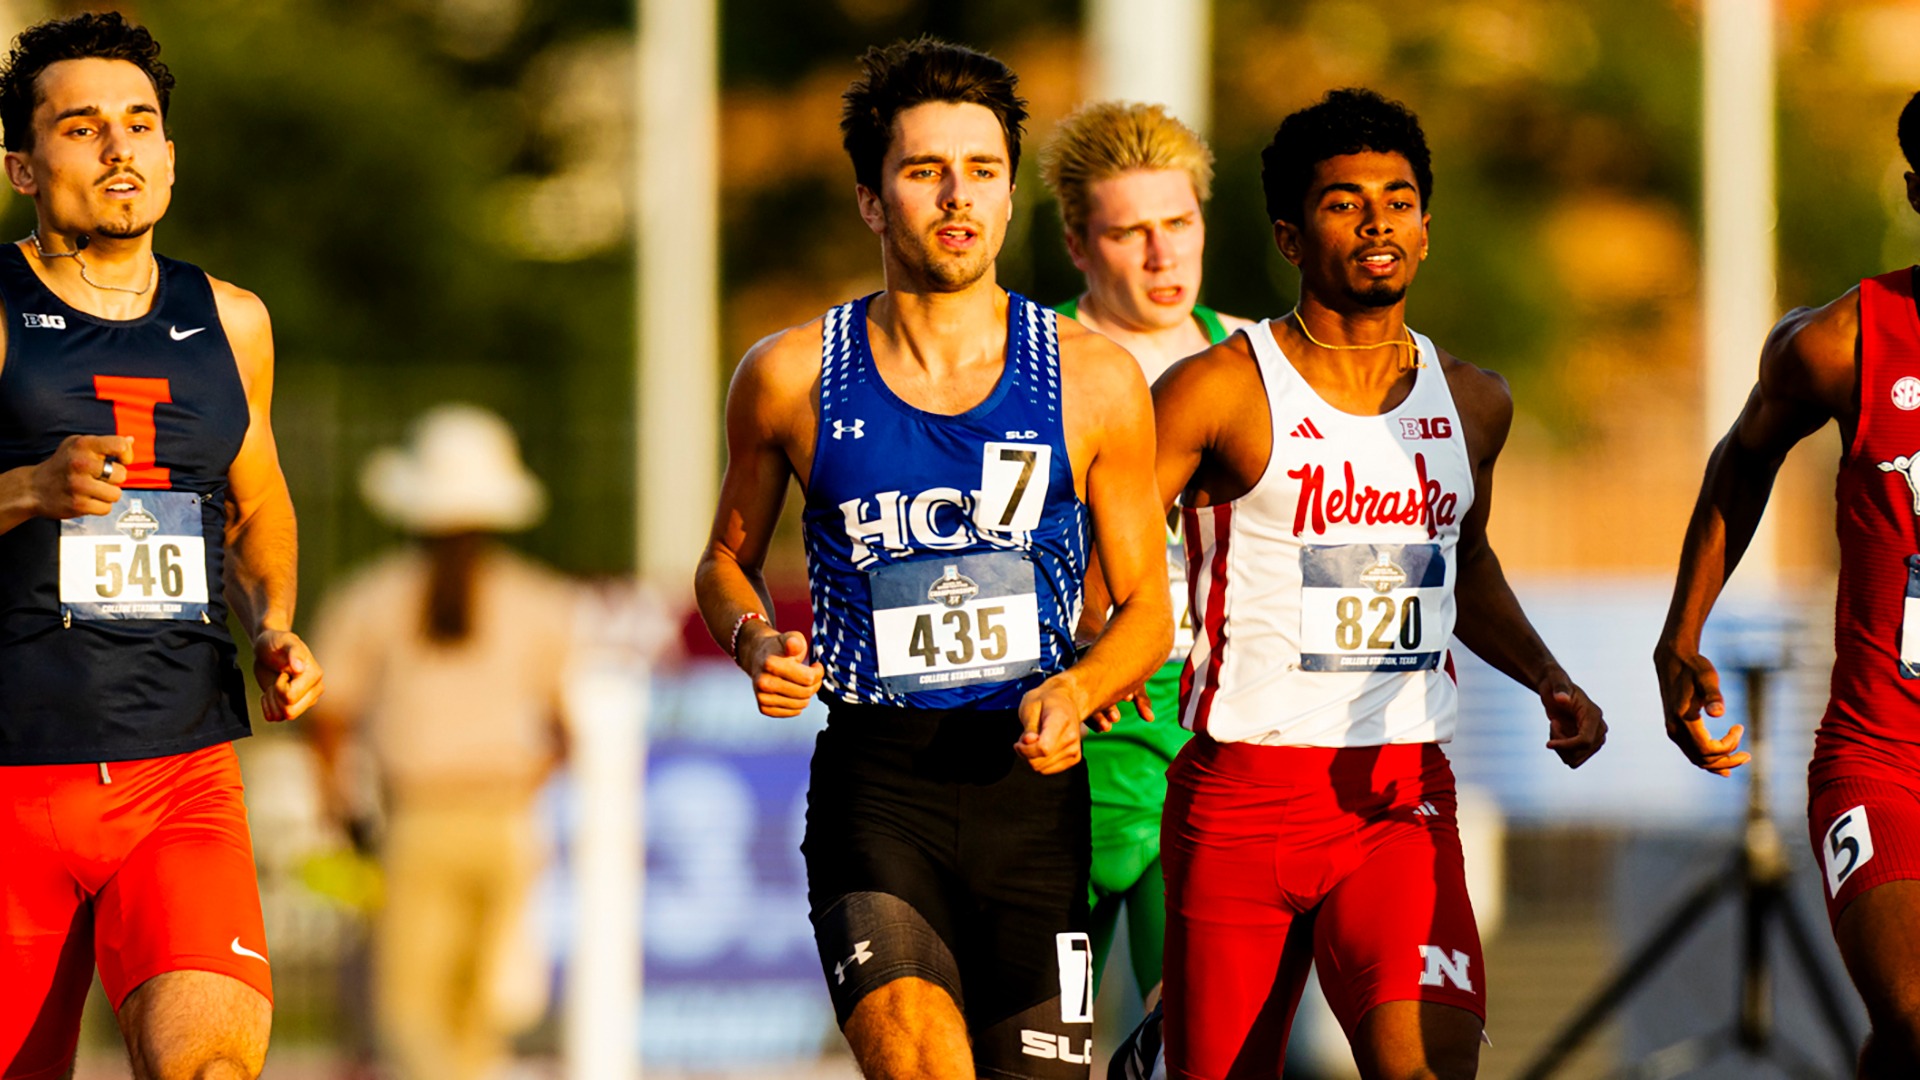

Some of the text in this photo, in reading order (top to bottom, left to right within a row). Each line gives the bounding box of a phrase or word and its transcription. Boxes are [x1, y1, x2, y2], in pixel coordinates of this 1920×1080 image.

[93, 374, 173, 489] I
[999, 449, 1037, 526] 7
[1287, 453, 1457, 539] Nebraska
[95, 544, 183, 598] 546
[909, 606, 1008, 667] 435
[1335, 596, 1421, 650] 820
[1399, 656, 1418, 665] TEXAS
[1829, 814, 1860, 883] 5
[1071, 939, 1088, 1016] 7
[1418, 945, 1474, 994] N
